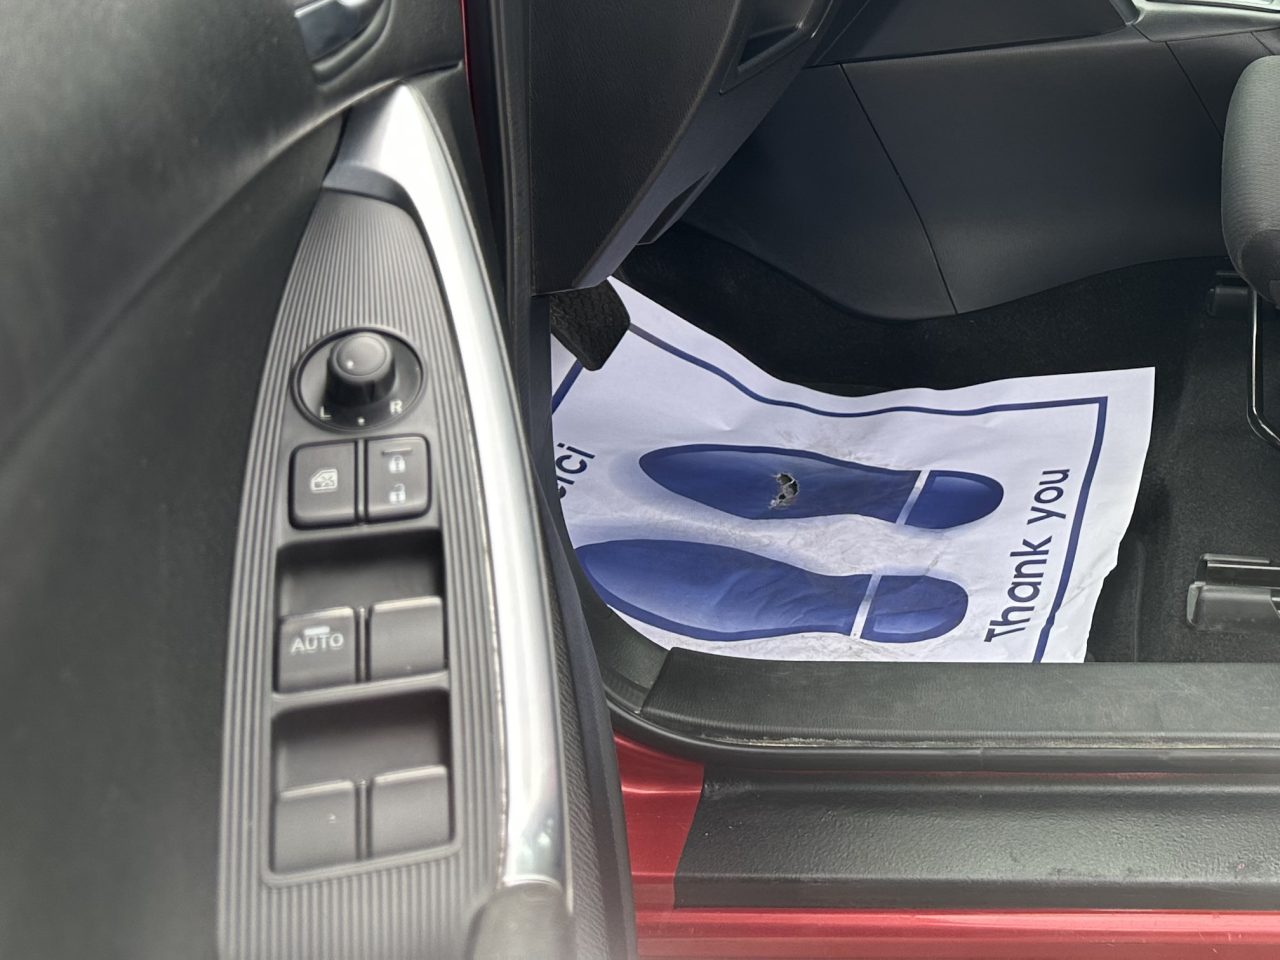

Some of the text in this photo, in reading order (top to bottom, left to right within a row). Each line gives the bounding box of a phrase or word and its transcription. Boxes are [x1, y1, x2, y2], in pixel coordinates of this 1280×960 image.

[320, 401, 402, 419] L R
[984, 469, 1070, 642] Thank you
[290, 633, 344, 654] AUTO
